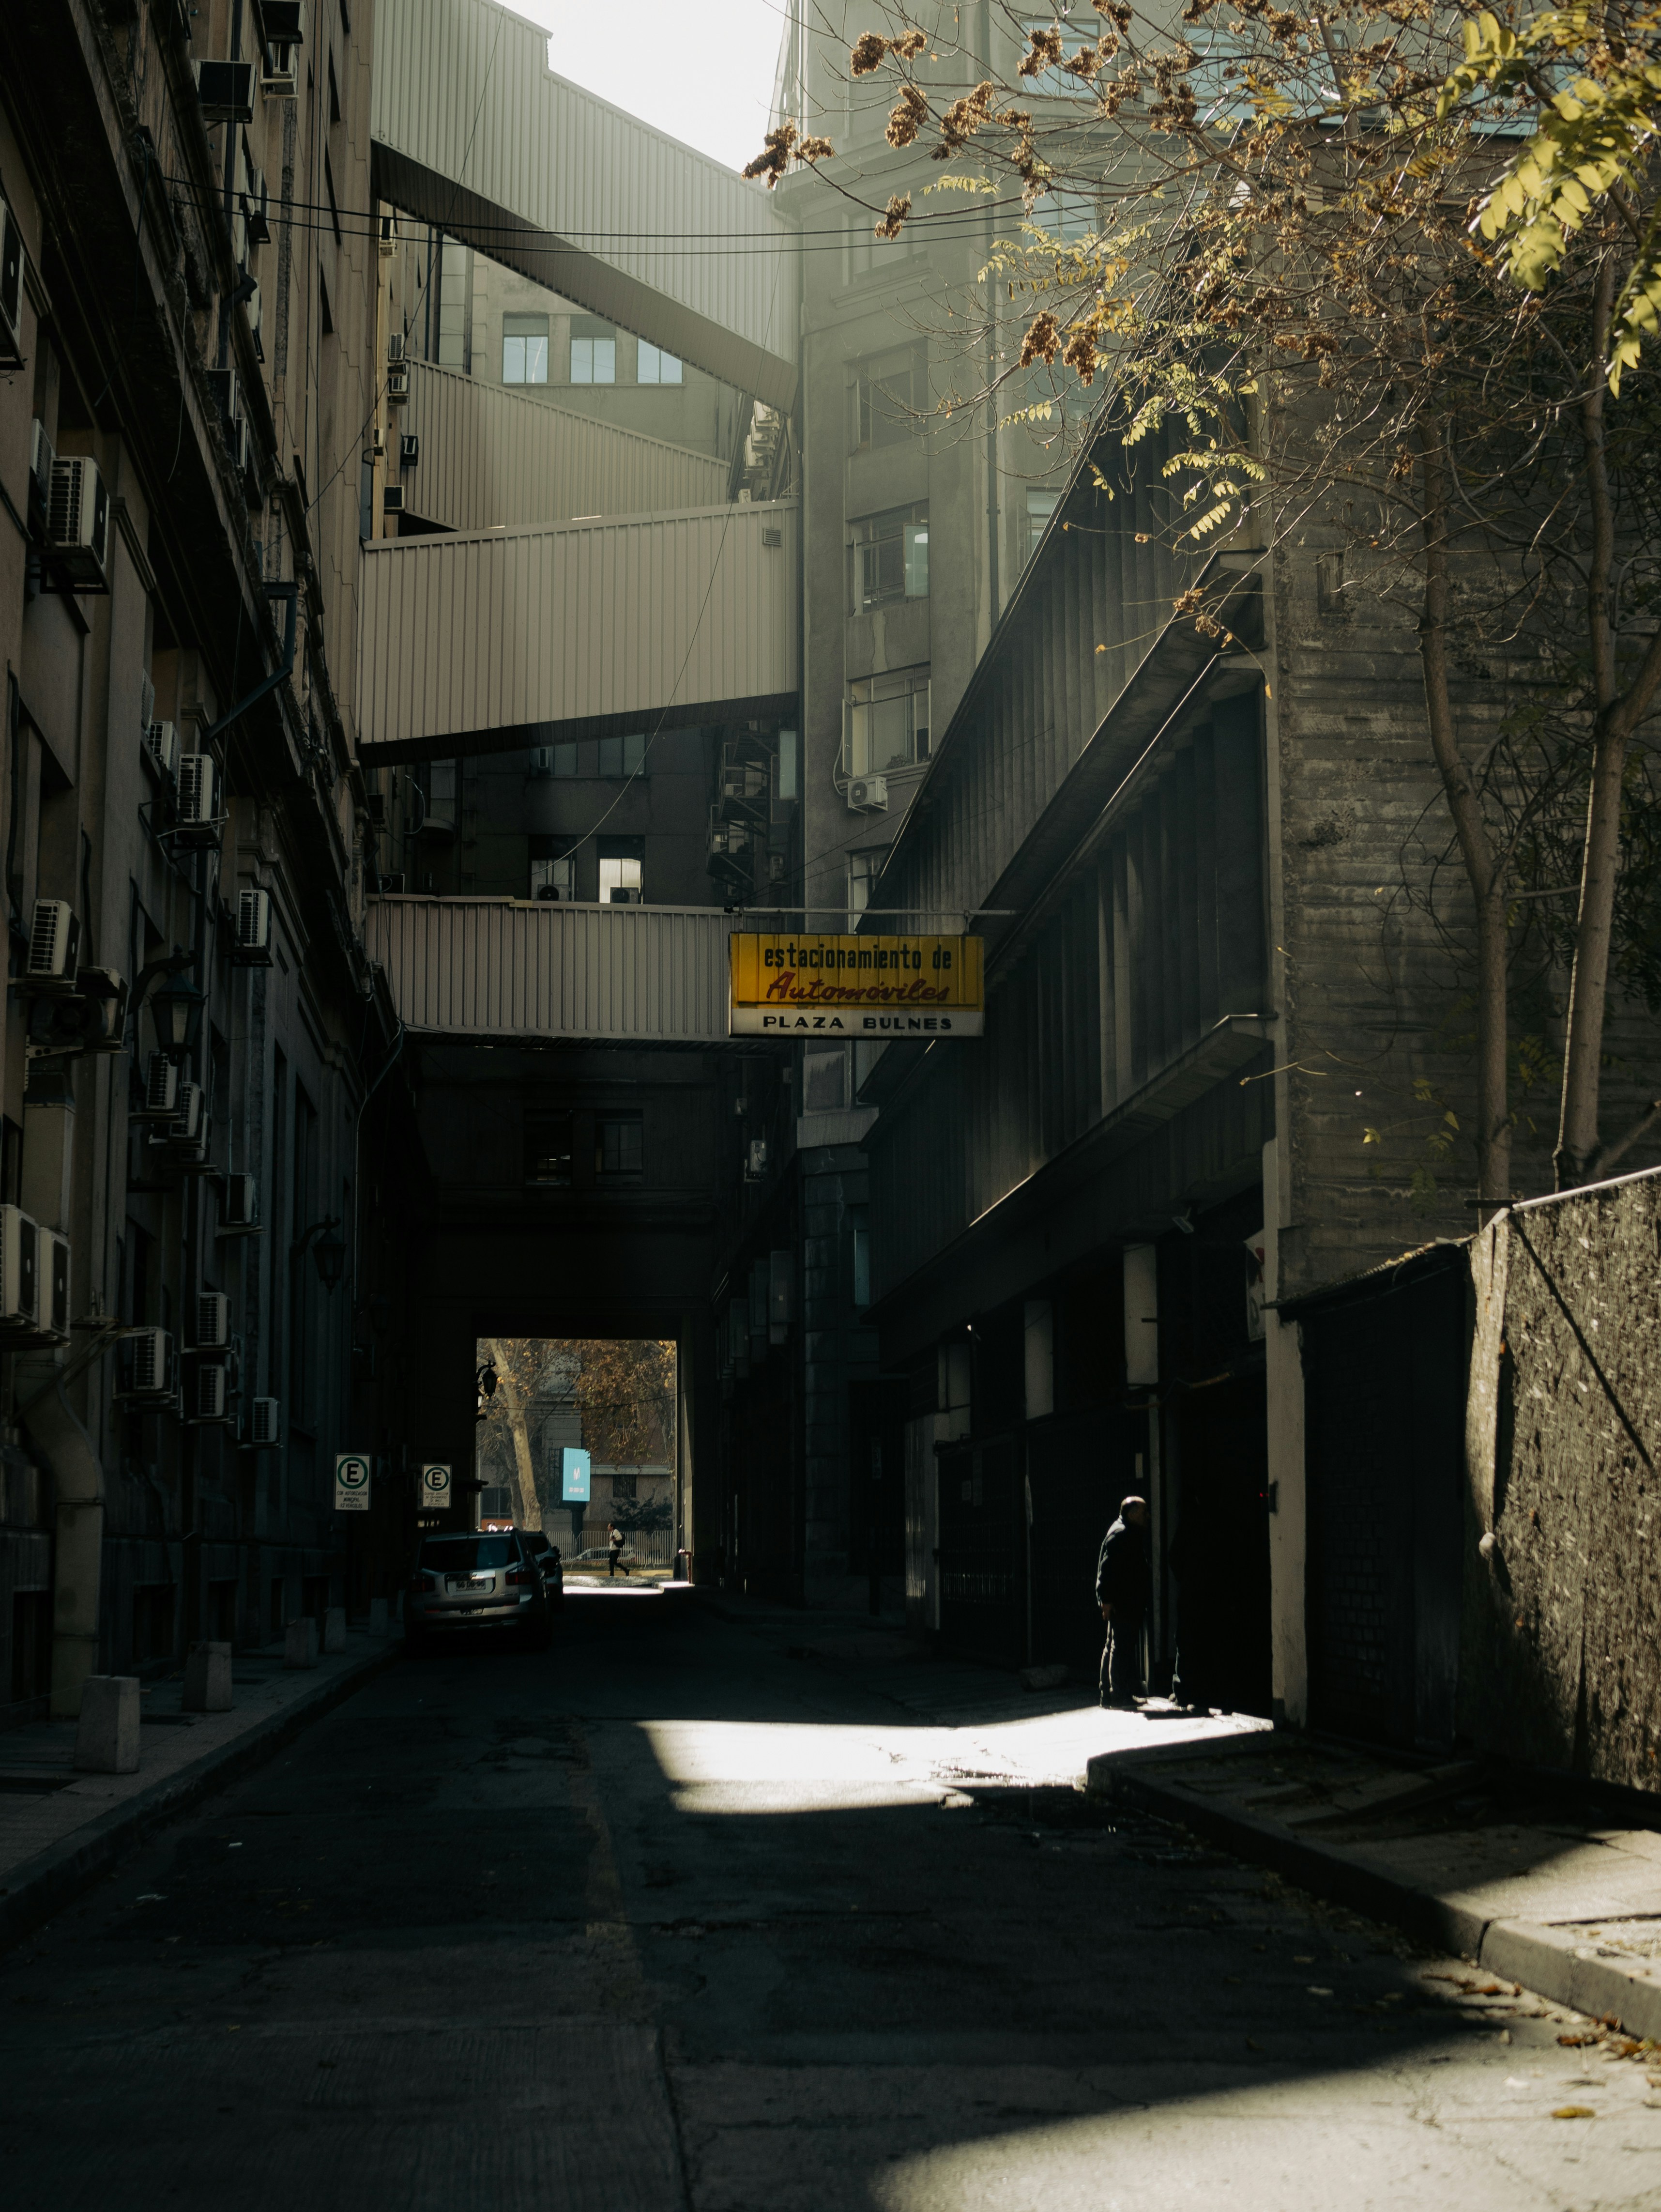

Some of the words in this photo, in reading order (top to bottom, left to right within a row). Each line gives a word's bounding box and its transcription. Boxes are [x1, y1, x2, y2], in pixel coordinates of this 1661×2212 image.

[764, 942, 921, 969] estacionamiento
[932, 944, 952, 969] de
[766, 970, 950, 1001] Automóviles
[763, 1015, 844, 1029] PLAZA
[863, 1017, 952, 1029] BULNES
[347, 1463, 359, 1482] E
[432, 1472, 442, 1486] E
